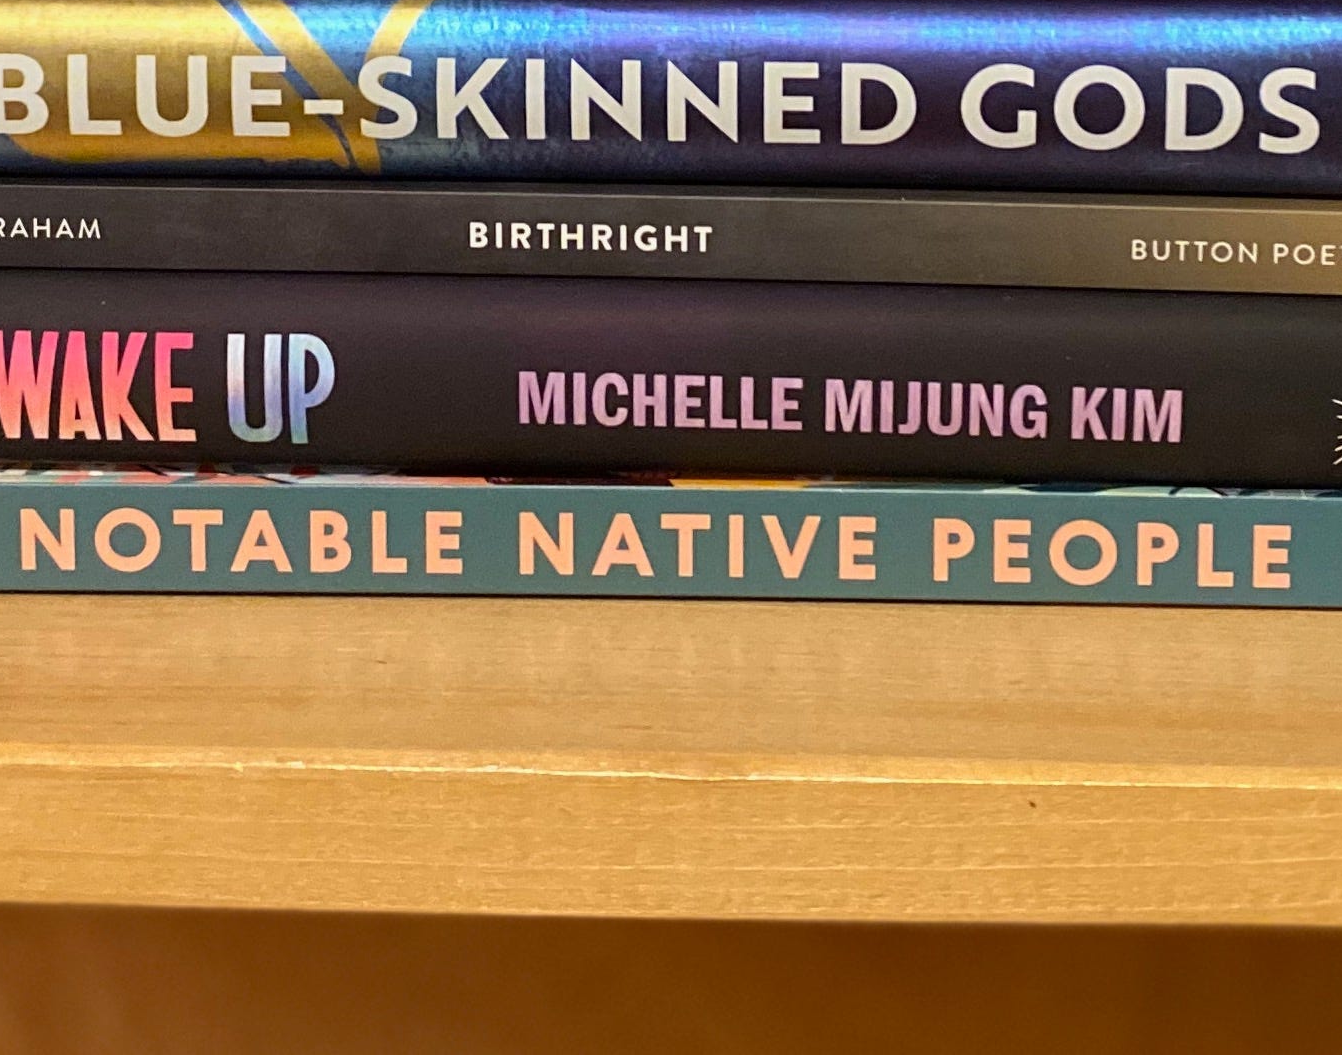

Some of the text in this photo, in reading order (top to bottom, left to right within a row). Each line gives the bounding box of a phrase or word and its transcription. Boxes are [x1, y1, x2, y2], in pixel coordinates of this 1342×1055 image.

[960, 63, 1321, 155] GODS
[470, 222, 713, 253] BIRTHRIGHT
[1131, 239, 1259, 264] BUTTON
[226, 333, 336, 445] UP
[517, 371, 1184, 443] MICHELLE MIJUNG KIM
[19, 507, 1292, 590] NOTABLE NATIVE PEOPLE
